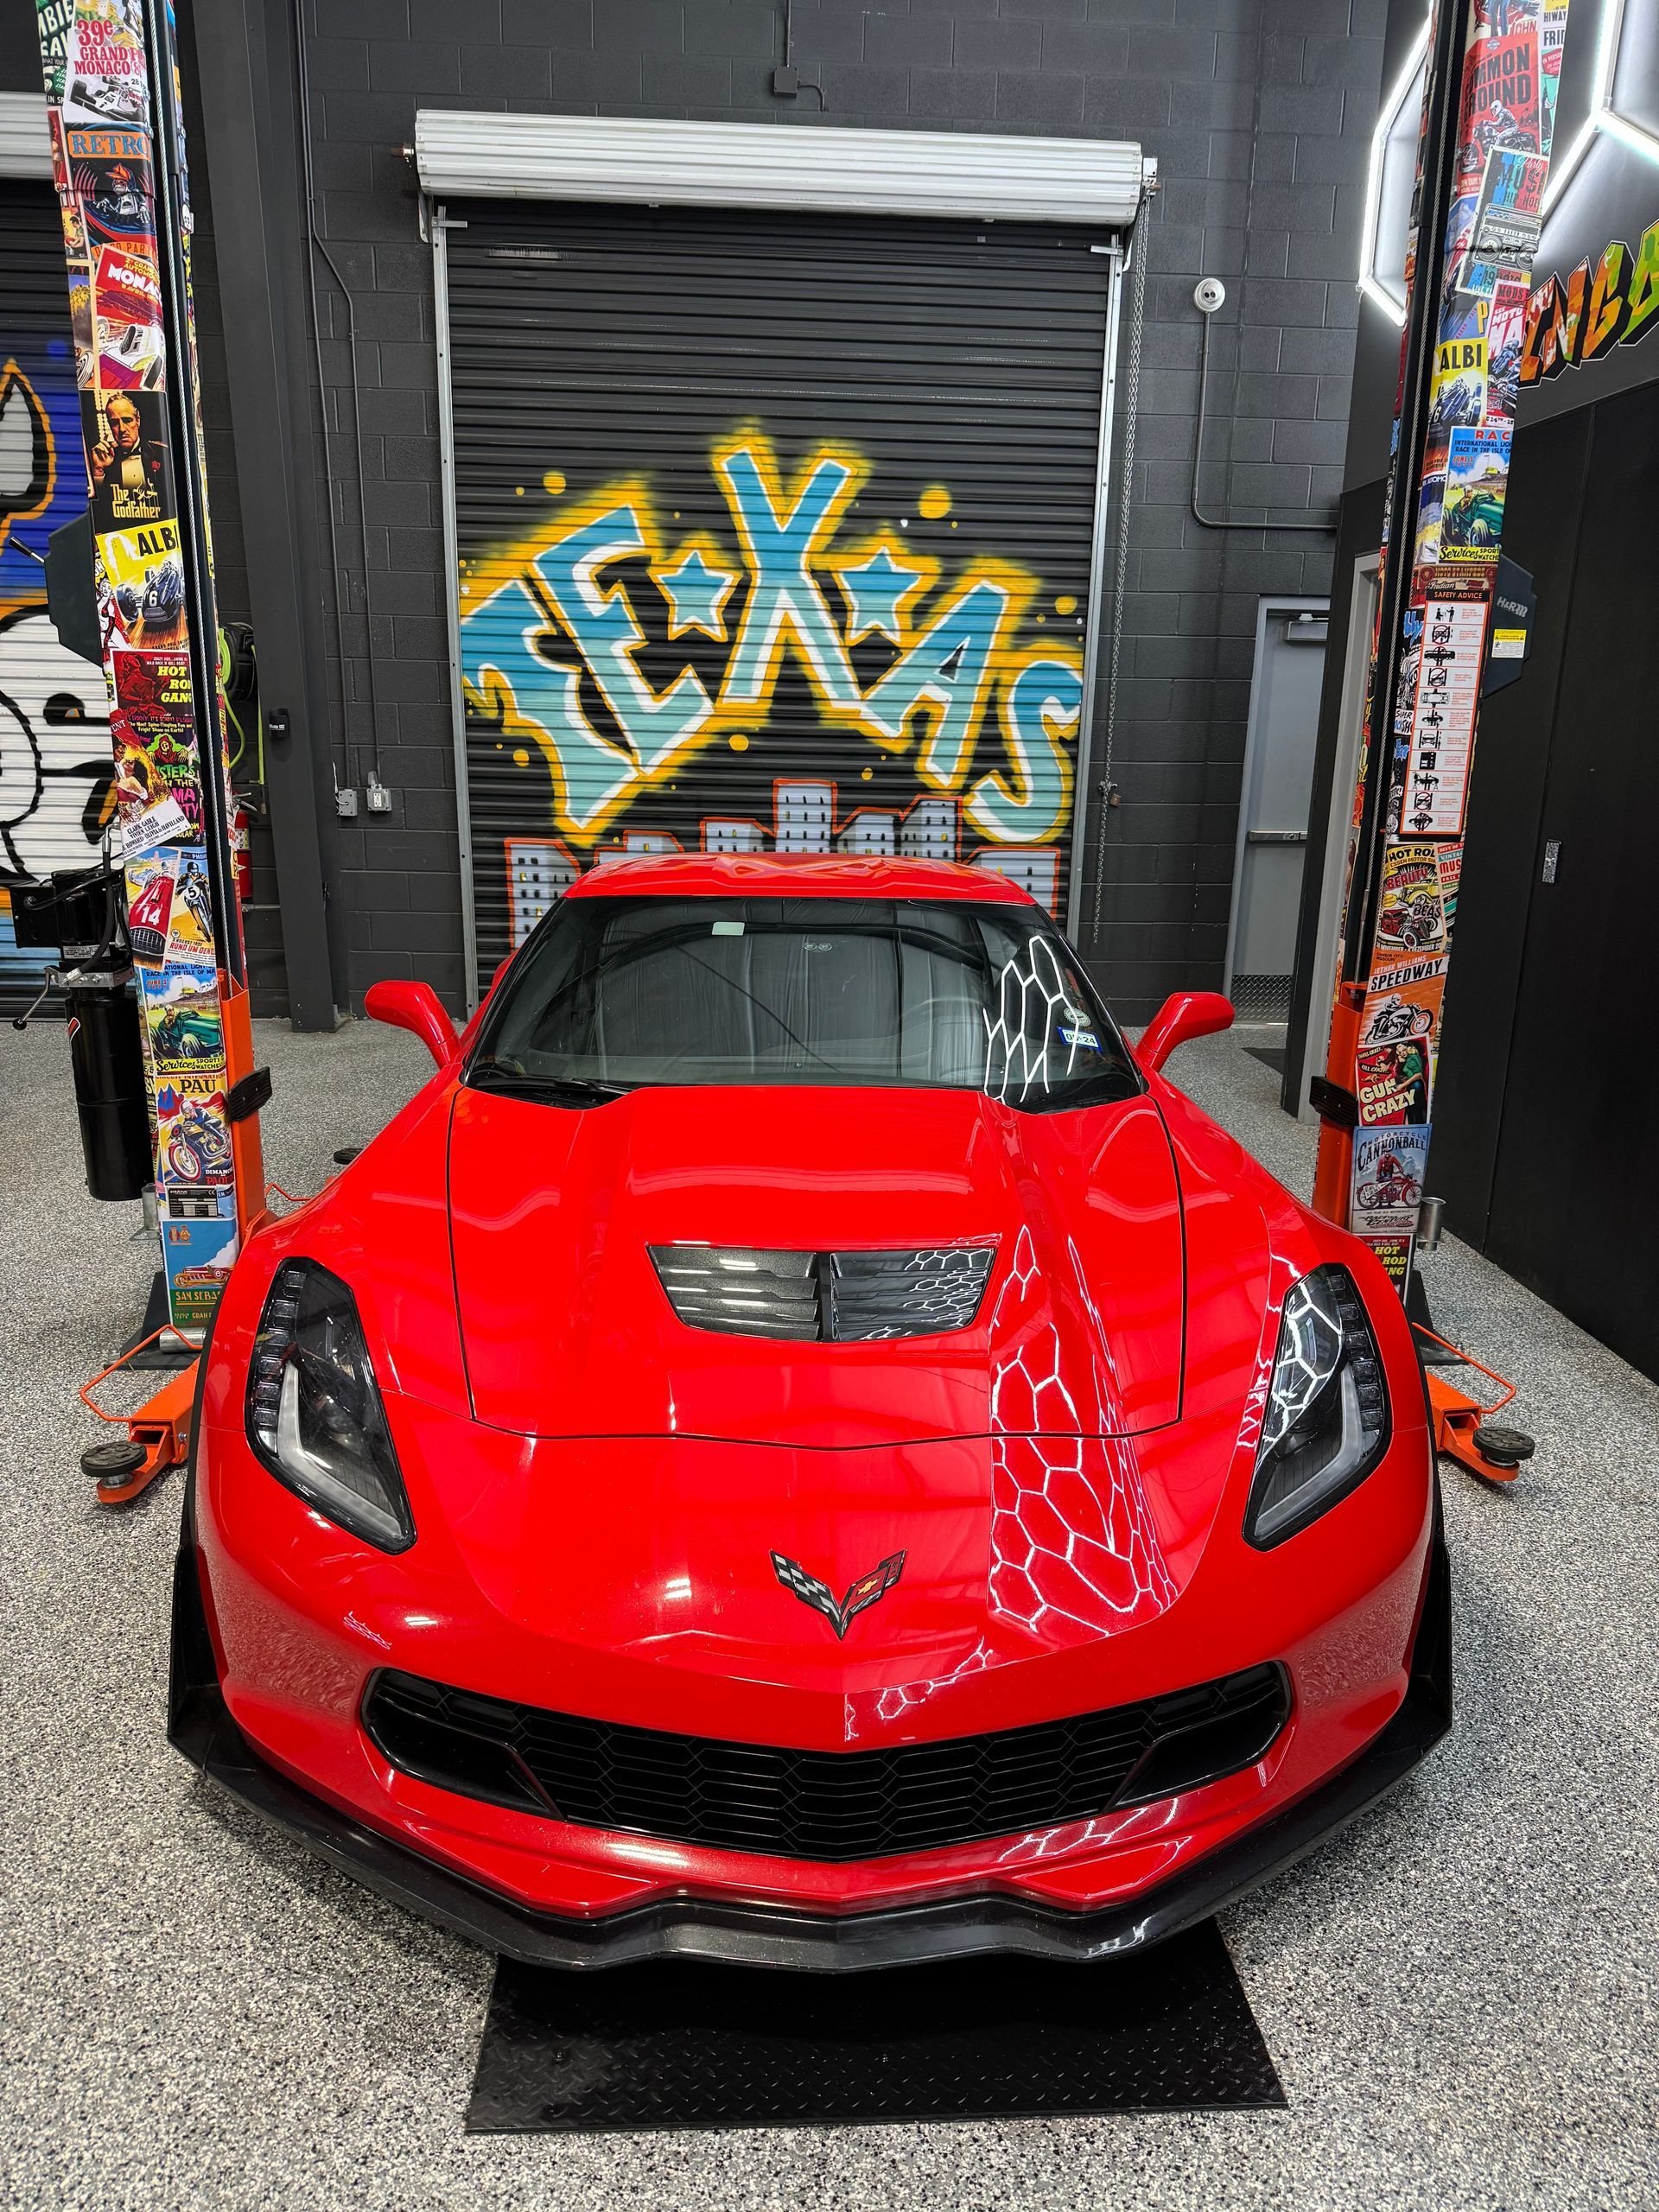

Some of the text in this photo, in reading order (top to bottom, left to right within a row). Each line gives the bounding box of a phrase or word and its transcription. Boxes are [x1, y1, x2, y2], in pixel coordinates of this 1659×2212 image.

[79, 47, 128, 60] GRAND
[74, 60, 130, 75] MONACO
[1440, 344, 1482, 372] ALBI
[111, 483, 130, 501] The
[111, 498, 162, 519] Godfather
[1439, 546, 1478, 560] Services
[149, 590, 158, 607] 6
[461, 443, 1083, 845] TEXAS
[157, 666, 187, 677] HOT
[156, 765, 196, 779] STERS
[175, 779, 194, 787] THE
[179, 803, 199, 819] TY
[127, 816, 157, 835] CLARK GABLE
[130, 821, 160, 840] VIVIEN LEIGH
[162, 816, 185, 831] HAVILLAND
[1389, 848, 1412, 862] HOT
[1387, 867, 1428, 890] BEAUTY
[188, 887, 197, 898] 5
[141, 906, 161, 926] 14
[168, 942, 188, 951] RUND
[188, 944, 198, 953] UM
[1374, 955, 1427, 975] ARTHUR WILLIAMS
[1370, 958, 1444, 991] SPEEDWAY
[156, 1059, 195, 1072] Services
[180, 1078, 216, 1093] PAU
[1359, 1077, 1397, 1104] GUN
[1362, 1089, 1415, 1122] CRAZY
[1367, 1131, 1426, 1147] MOTORCYCLE
[1357, 1136, 1426, 1172] CANNONBALL
[1375, 1246, 1400, 1255] HOT
[1382, 1256, 1408, 1265] ROD
[175, 1291, 192, 1300] SAN
